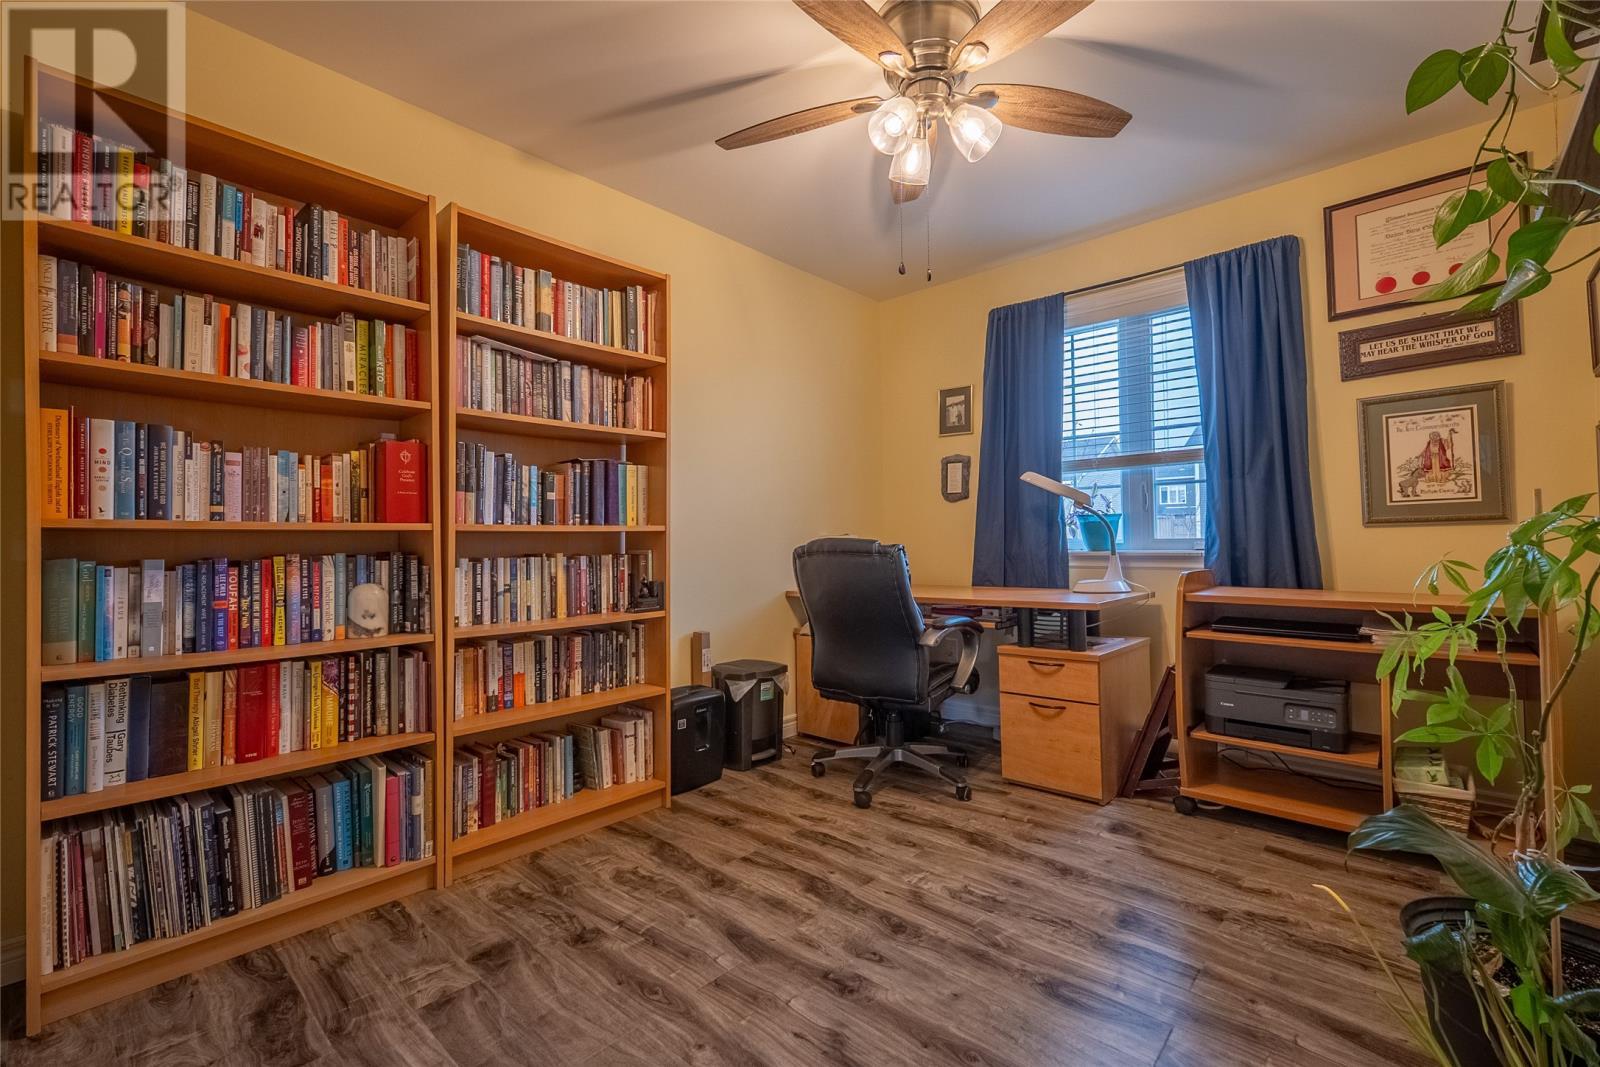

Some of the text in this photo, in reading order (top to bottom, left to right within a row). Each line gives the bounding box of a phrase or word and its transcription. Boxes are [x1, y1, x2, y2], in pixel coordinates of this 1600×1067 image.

[81, 138, 91, 175] FINDING
[295, 226, 303, 262] SNOWDEN
[40, 300, 54, 334] PRAYER
[1360, 330, 1494, 359] MAY HEAR THE WHISPER OF GOD
[1368, 325, 1480, 351] LET US BE SILENT THAT WE
[358, 343, 367, 394] MIRACLES
[376, 360, 384, 383] KETO
[176, 473, 184, 482] TO
[80, 563, 93, 583] God
[228, 569, 238, 612] TOUFAH
[117, 596, 125, 621] JESUS
[241, 612, 250, 629] Push
[193, 678, 201, 690] Bad
[67, 694, 76, 723] ENERGY
[76, 696, 84, 719] GOOD
[107, 682, 118, 718] Diabetes
[116, 681, 128, 724] Rethinking
[192, 691, 201, 714] Therapy
[192, 715, 200, 738] Abigail
[47, 714, 57, 788] PATRICK STEWART
[105, 734, 117, 764] Taubes
[114, 732, 126, 752] Gary
